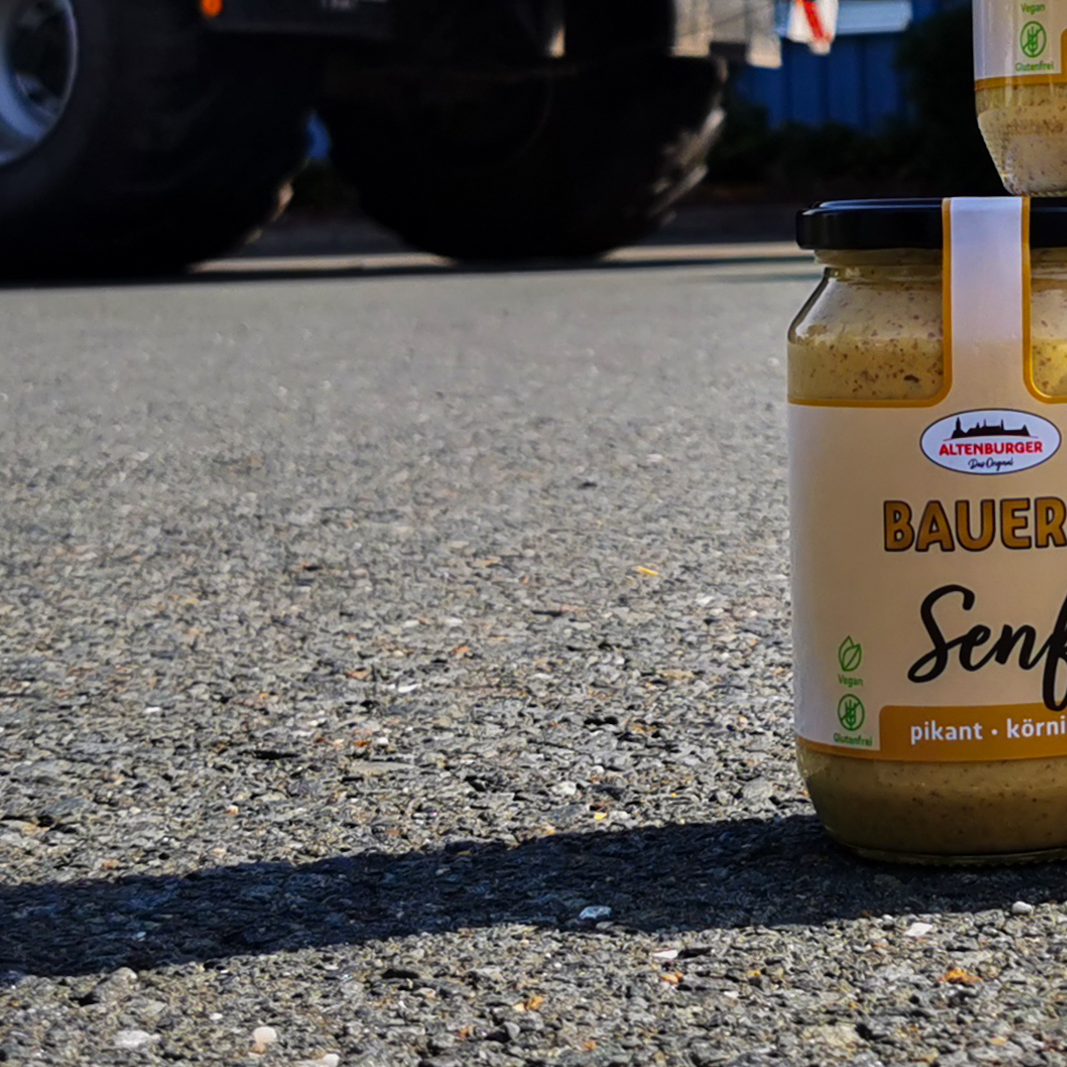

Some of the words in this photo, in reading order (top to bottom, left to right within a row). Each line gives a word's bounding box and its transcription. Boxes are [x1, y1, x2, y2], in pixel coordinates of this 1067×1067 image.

[1020, 2, 1046, 15] Vegan
[1014, 60, 1054, 73] Glutenfrei
[939, 441, 1043, 456] ALTENBURGER
[838, 674, 864, 688] Vegan
[833, 732, 873, 747] Glutenfrei
[910, 720, 983, 745] pikant
